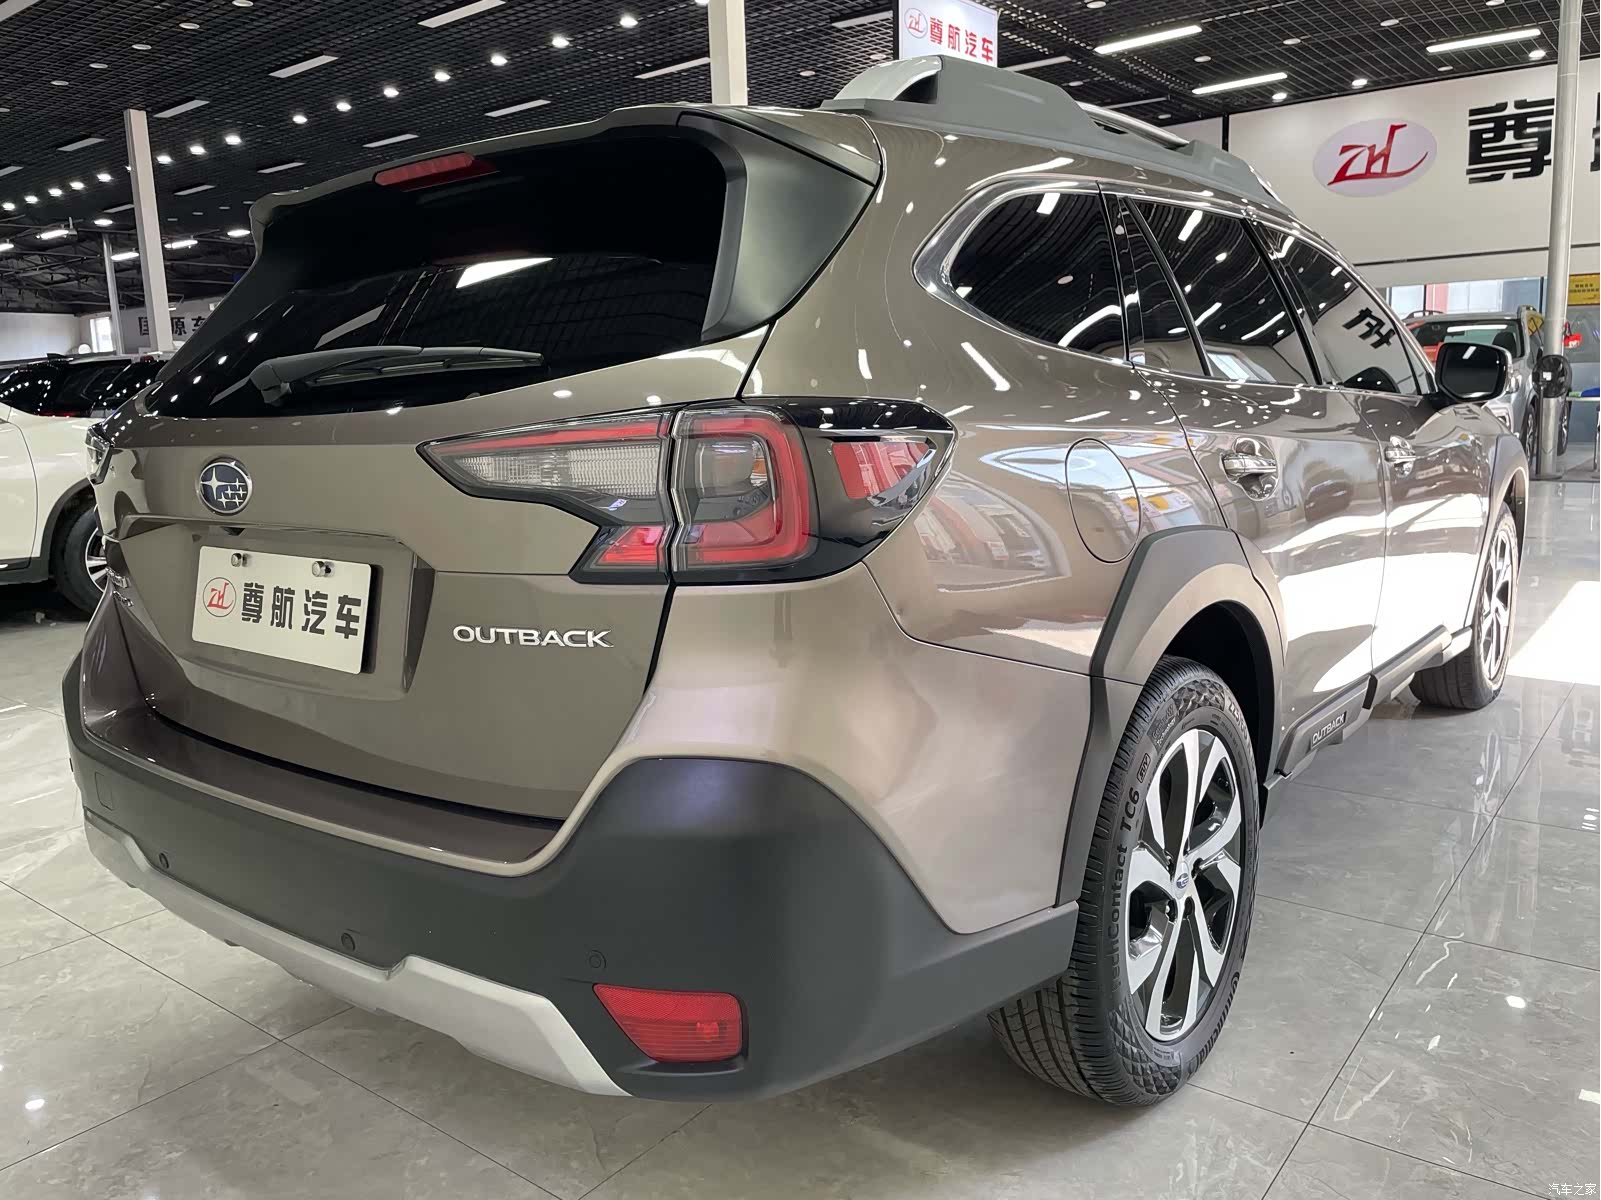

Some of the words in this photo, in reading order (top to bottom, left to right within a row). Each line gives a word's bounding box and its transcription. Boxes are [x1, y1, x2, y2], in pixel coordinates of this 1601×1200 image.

[929, 16, 994, 63] 尊航汽车
[1466, 92, 1600, 184] 尊
[241, 581, 362, 639] 尊航汽车
[452, 625, 615, 648] OUTBACK
[1312, 712, 1346, 745] OUTBACK
[1120, 787, 1140, 832] TC6
